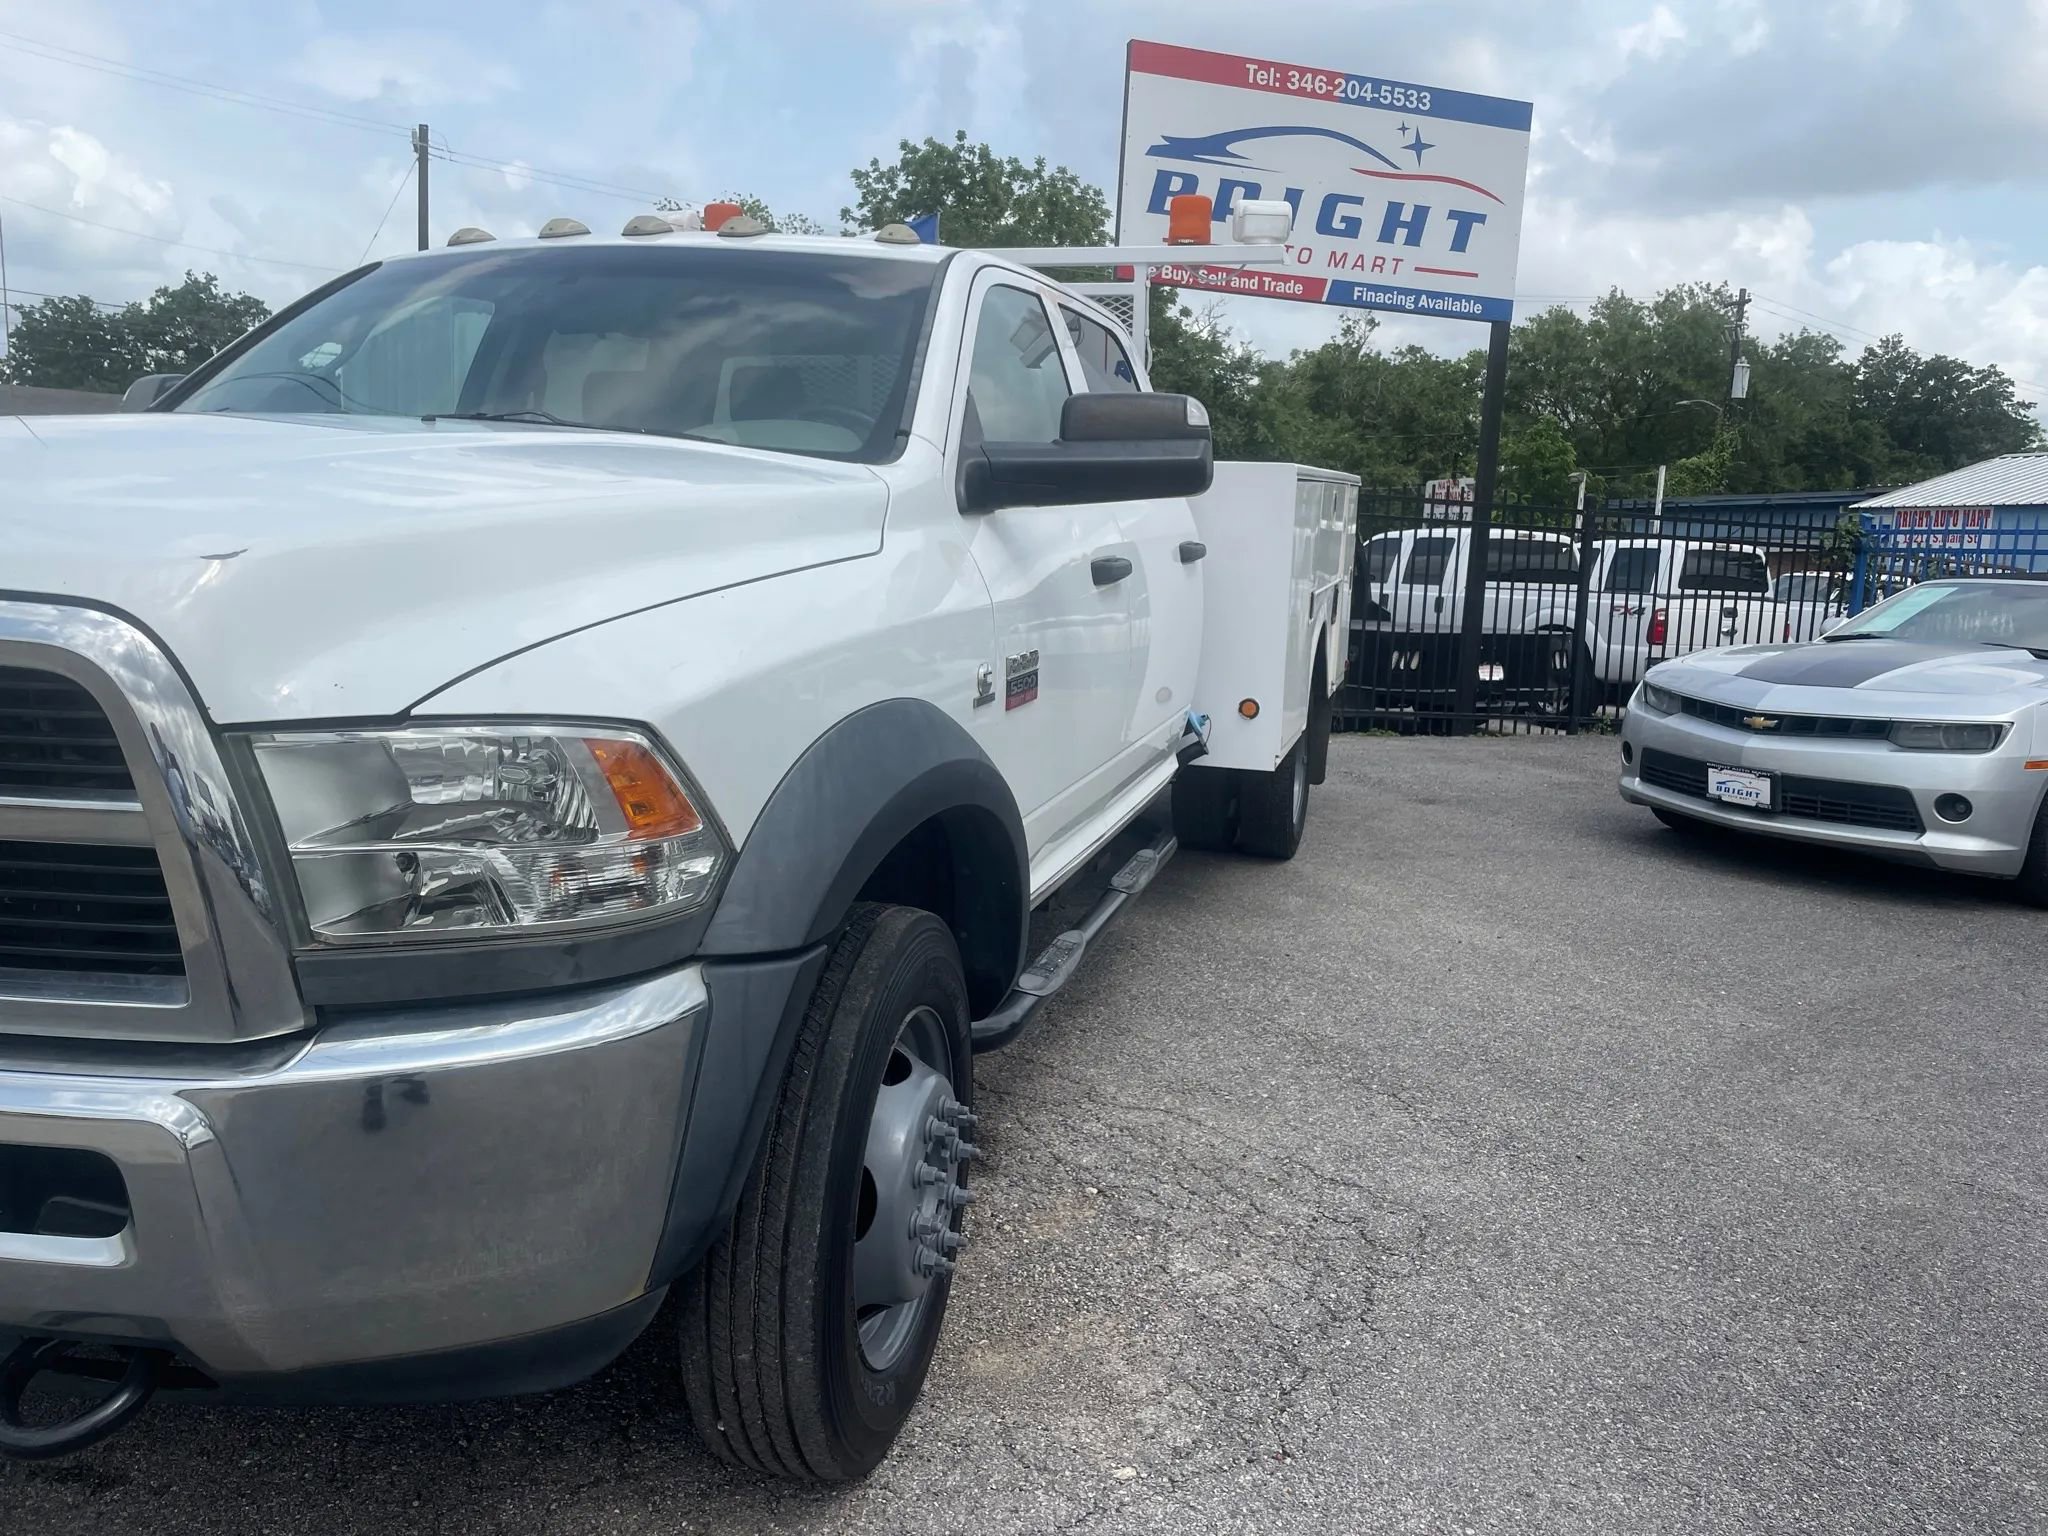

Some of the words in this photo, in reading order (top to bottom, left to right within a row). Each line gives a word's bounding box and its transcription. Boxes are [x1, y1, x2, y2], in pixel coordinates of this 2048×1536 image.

[1246, 64, 1280, 87] Tel:
[1287, 71, 1431, 111] 346-204-5533
[1328, 250, 1404, 275] MART
[1161, 265, 1193, 284] Buy,
[1199, 270, 1226, 287] Sell
[1231, 276, 1259, 290] and
[1263, 277, 1304, 295] Trade
[1353, 286, 1416, 309] Finacing
[1418, 294, 1483, 314] Available
[1011, 675, 1037, 695] 5500
[1716, 785, 1761, 799] BRIGHT
